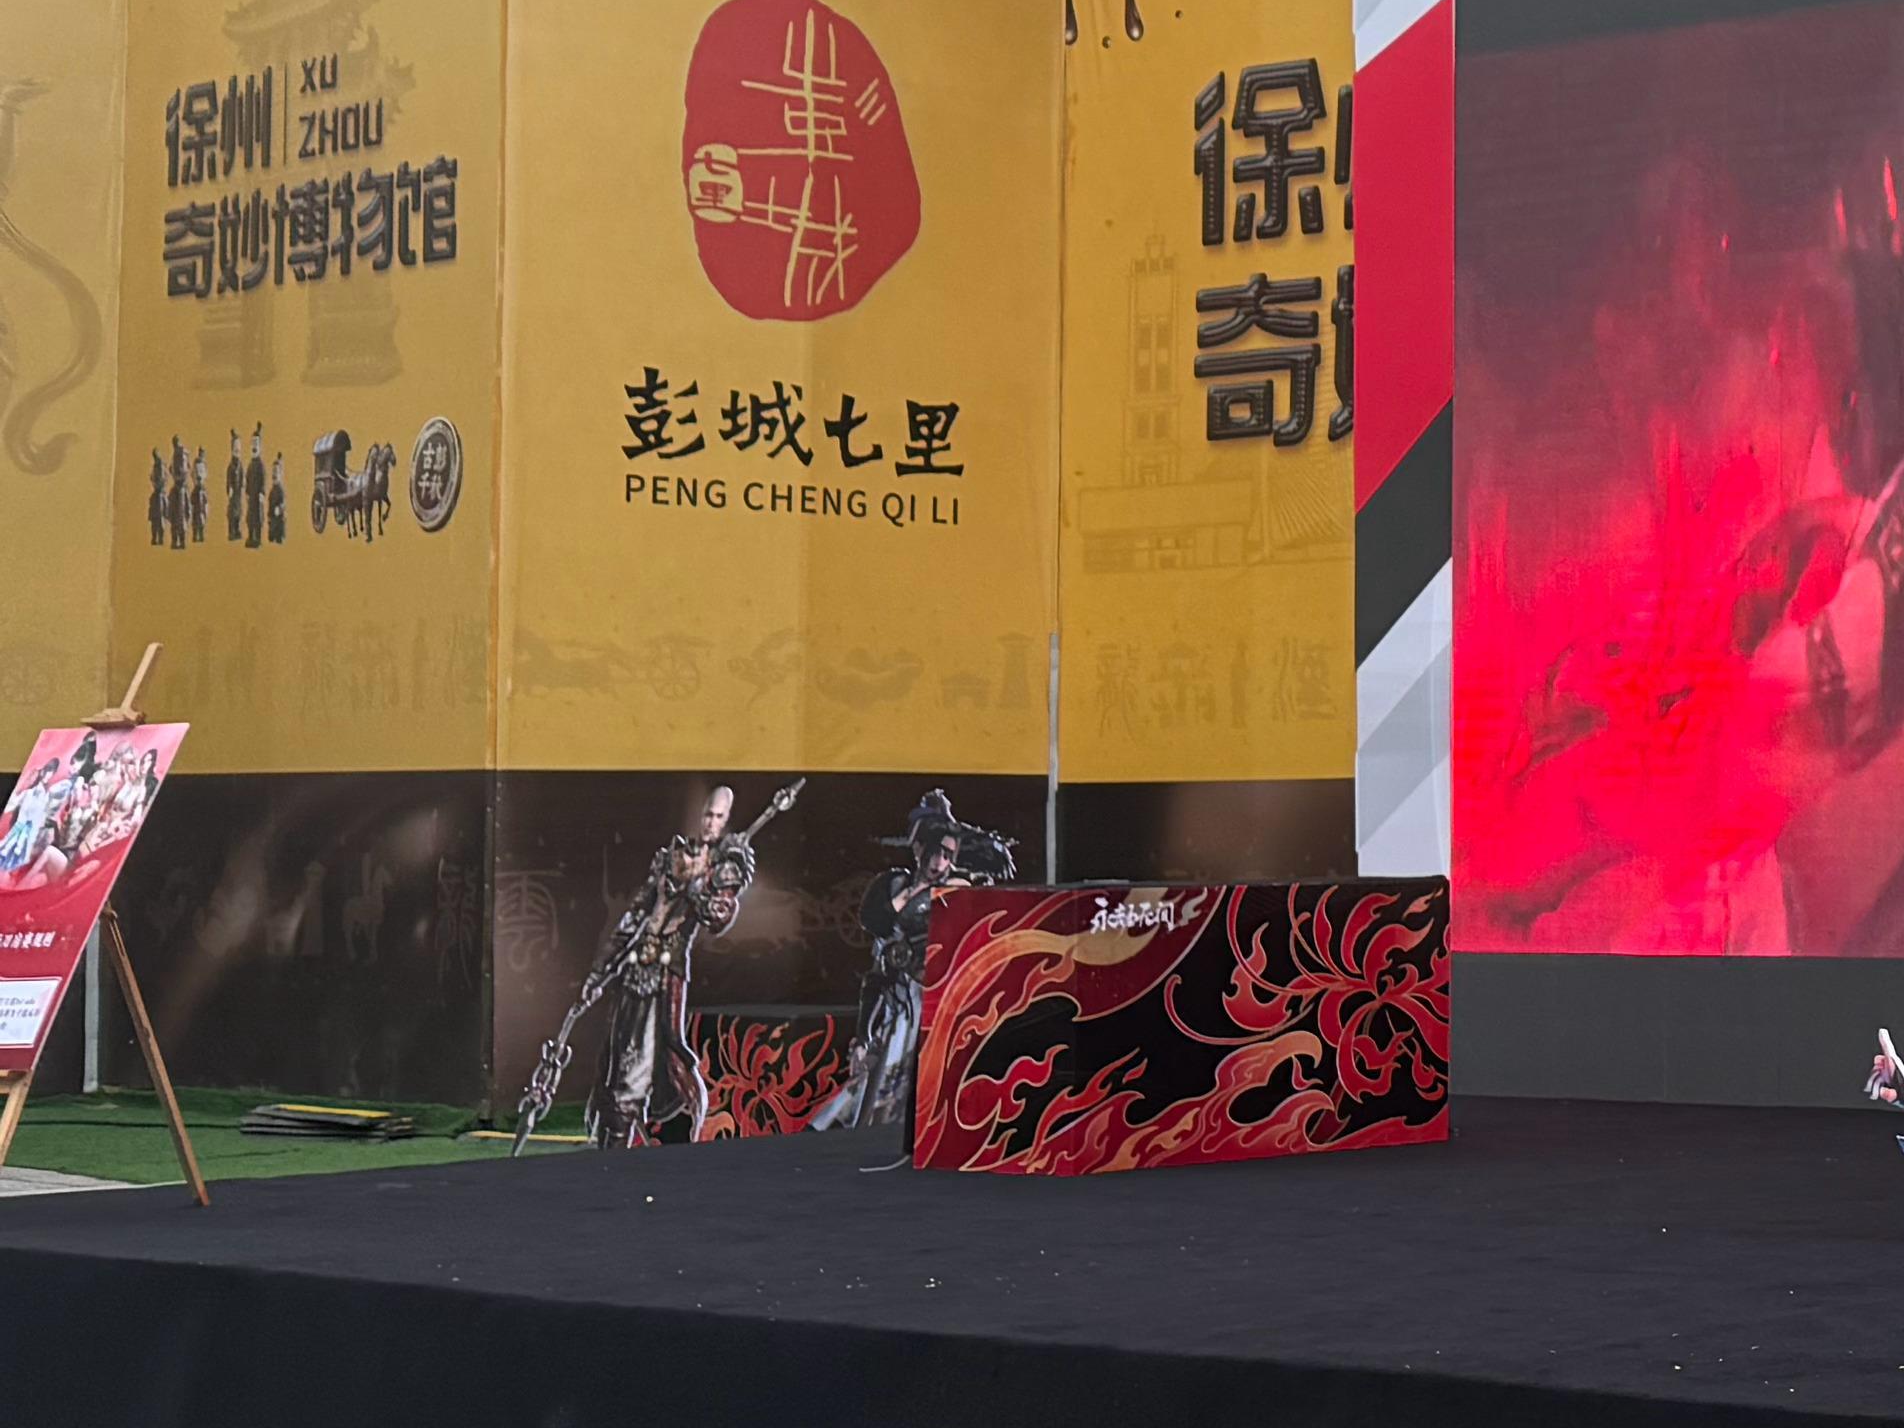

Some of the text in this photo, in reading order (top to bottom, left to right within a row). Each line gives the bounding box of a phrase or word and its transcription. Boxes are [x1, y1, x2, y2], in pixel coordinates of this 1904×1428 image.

[164, 64, 272, 188] 徐州
[298, 98, 384, 160] ZHOU
[299, 53, 338, 94] XU
[1195, 56, 1353, 246] 徐
[163, 155, 458, 299] 奇妙博物馆
[1195, 262, 1353, 448] 奇
[621, 366, 965, 477] 彭城七里
[625, 474, 960, 528] PENG CHENG QI LI
